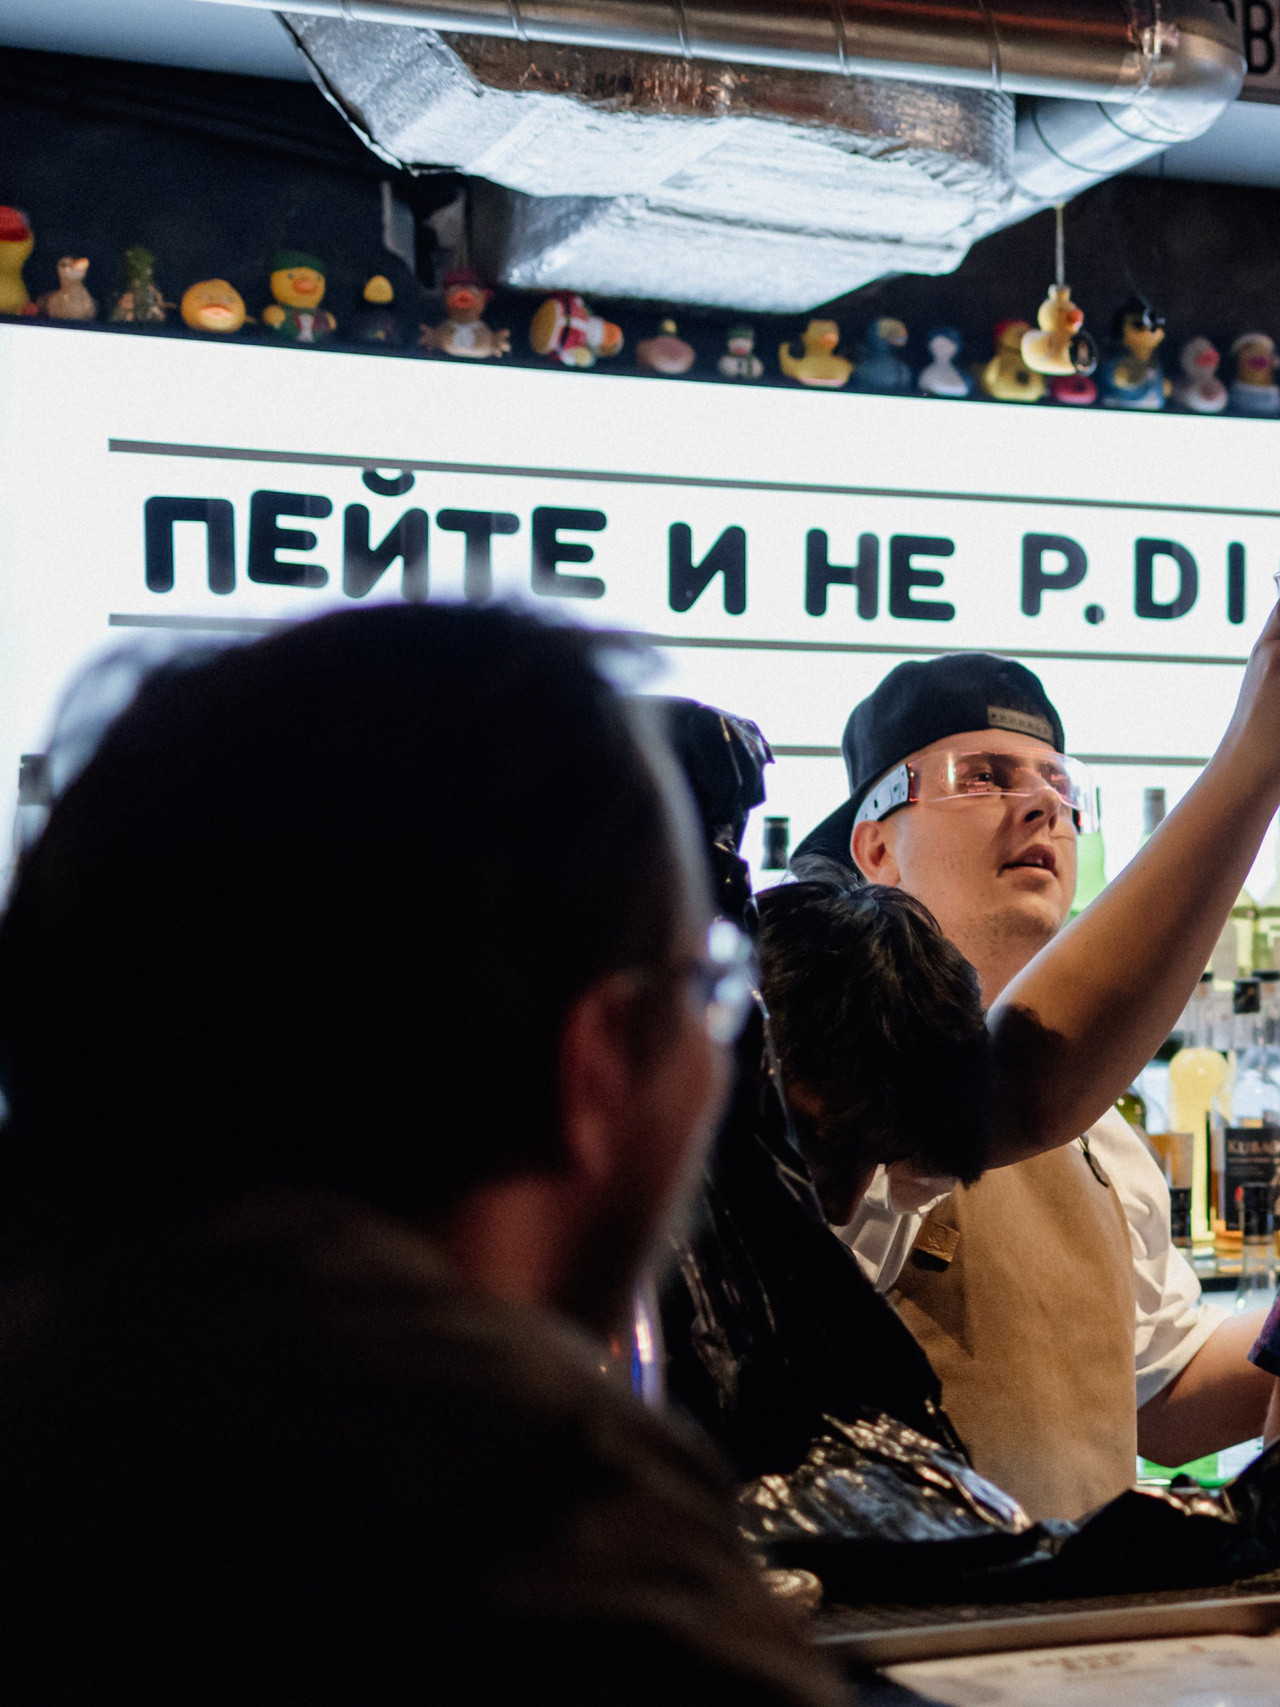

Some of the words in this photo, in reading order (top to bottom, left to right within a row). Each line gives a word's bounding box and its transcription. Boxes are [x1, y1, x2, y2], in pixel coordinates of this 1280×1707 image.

[143, 466, 608, 602] ПЕЙТЕ
[668, 521, 747, 615] И
[804, 527, 956, 622] НЕ
